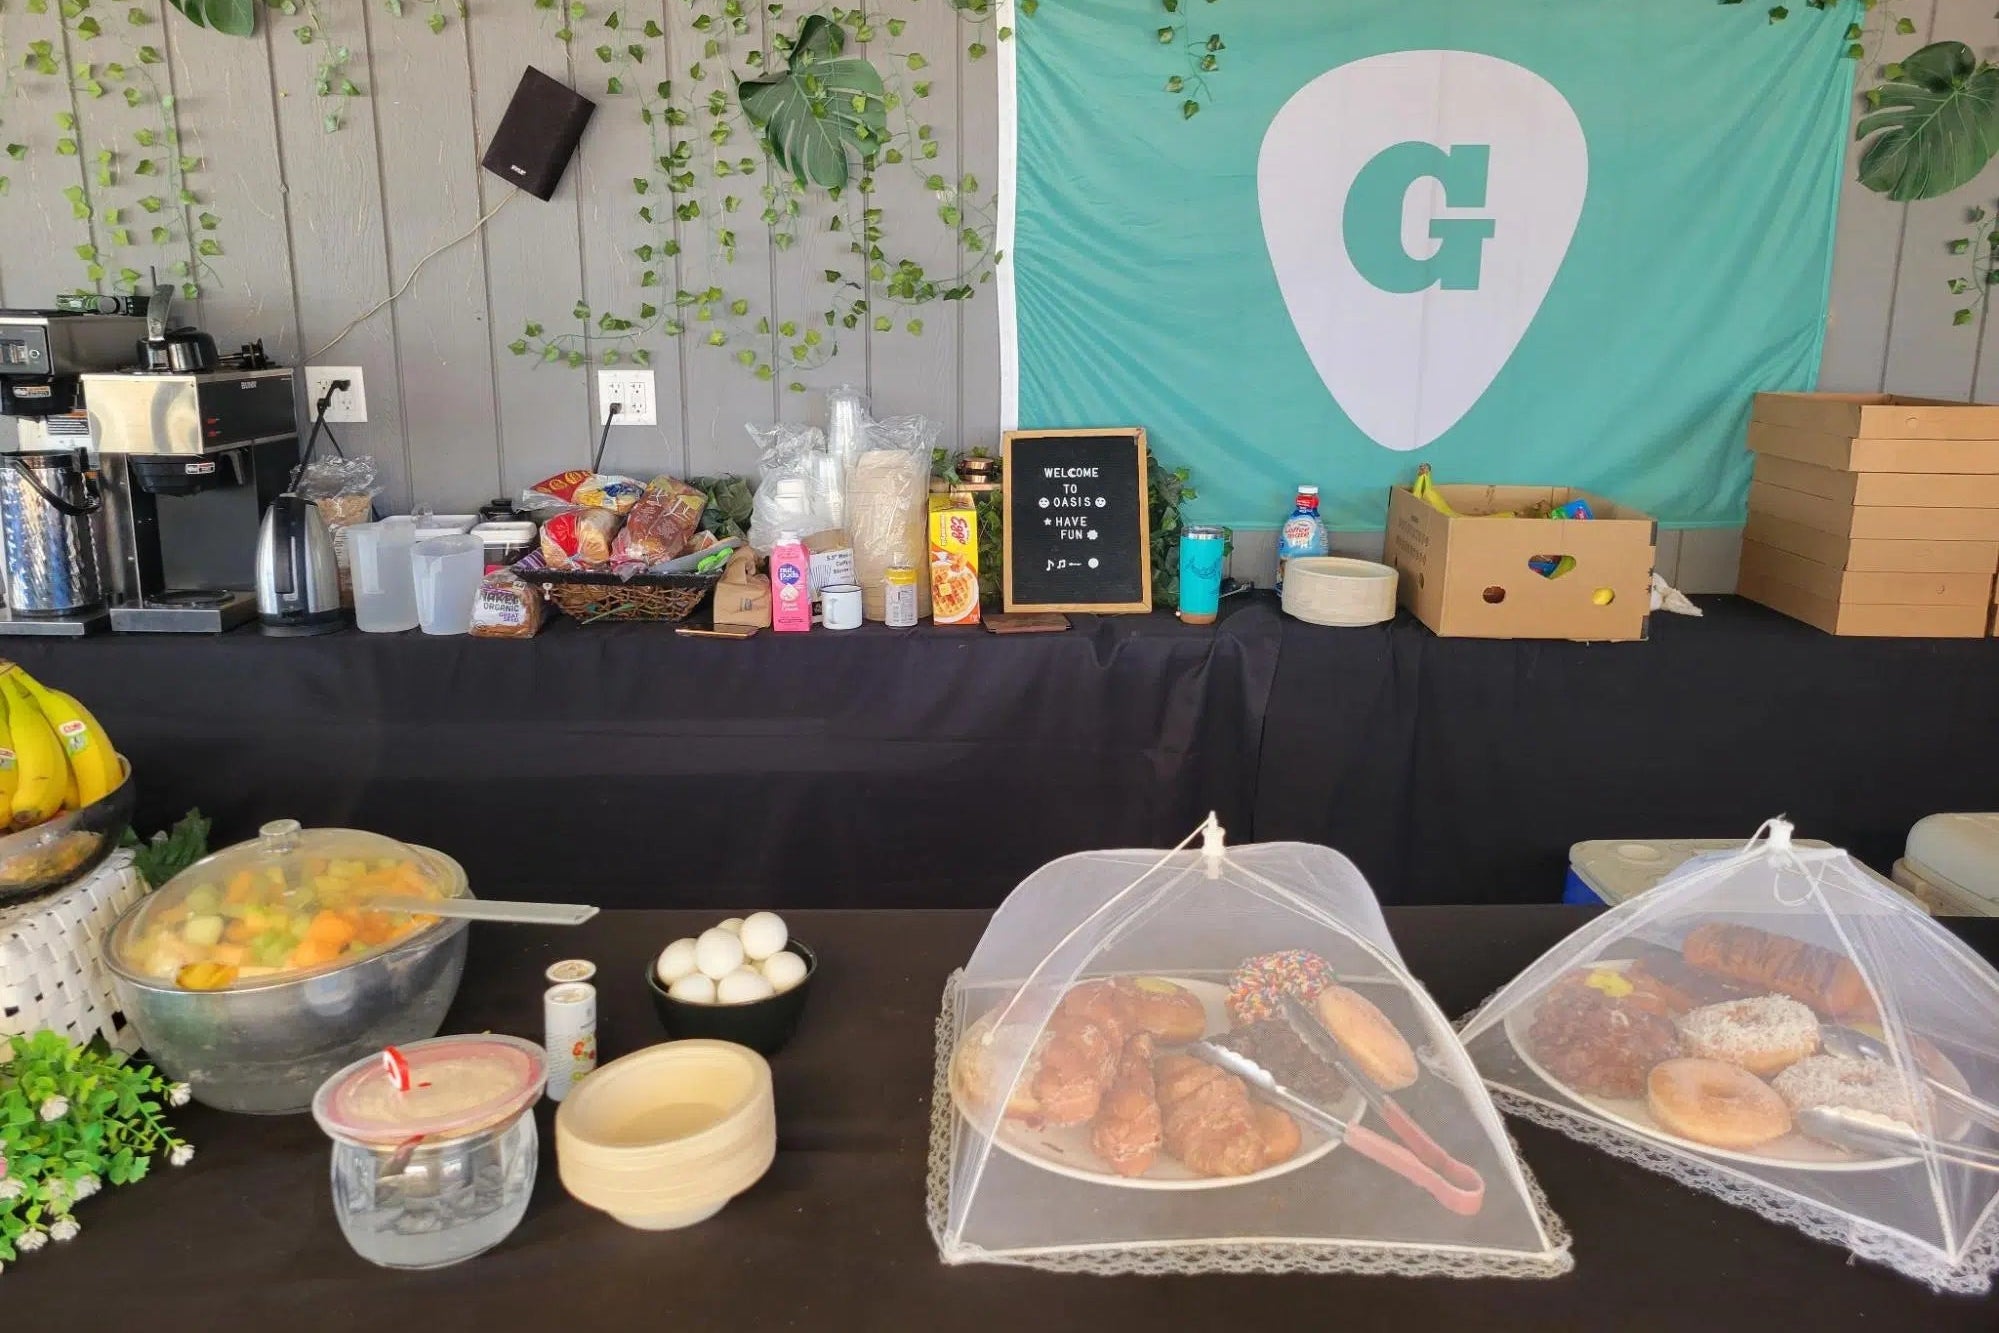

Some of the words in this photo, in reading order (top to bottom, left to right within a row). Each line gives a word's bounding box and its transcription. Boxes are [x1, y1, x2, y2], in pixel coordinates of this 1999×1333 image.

[1342, 140, 1496, 294] G
[1043, 467, 1099, 478] WELCOME
[1062, 483, 1078, 494] TO
[1053, 496, 1091, 508] OASIS
[1055, 516, 1088, 527] HAVE
[951, 515, 968, 545] Eggo
[1060, 529, 1083, 540] FUN
[483, 602, 520, 612] ORGANIC
